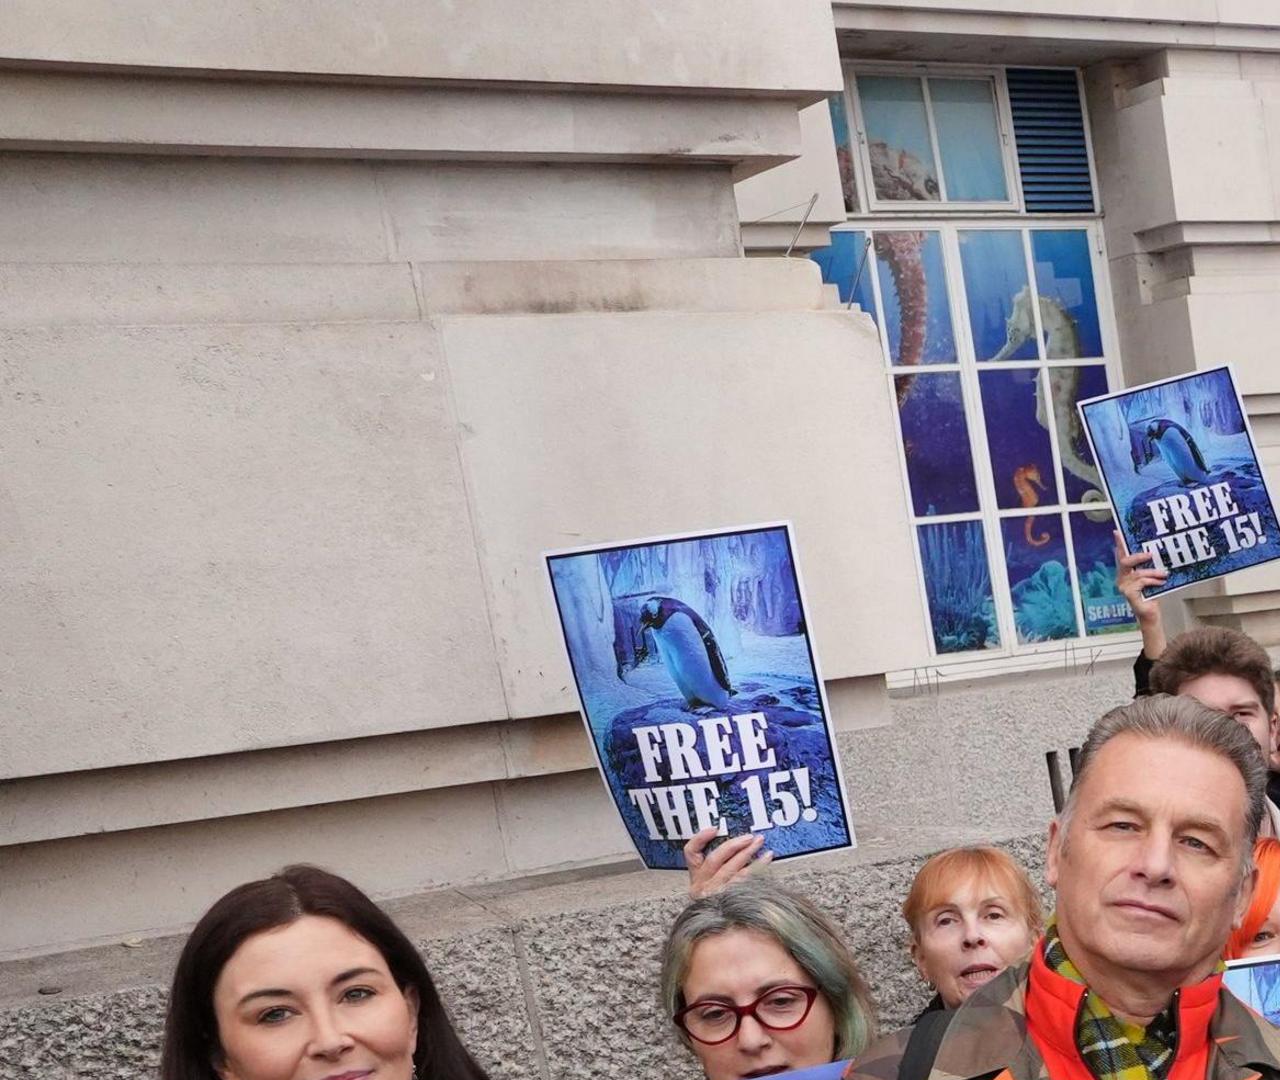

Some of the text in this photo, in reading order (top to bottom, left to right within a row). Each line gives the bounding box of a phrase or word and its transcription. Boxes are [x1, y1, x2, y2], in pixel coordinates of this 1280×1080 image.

[1146, 482, 1240, 532] FREE
[1142, 511, 1268, 571] THE 15!
[631, 711, 777, 783] FREE
[628, 768, 819, 841] THE 15!
